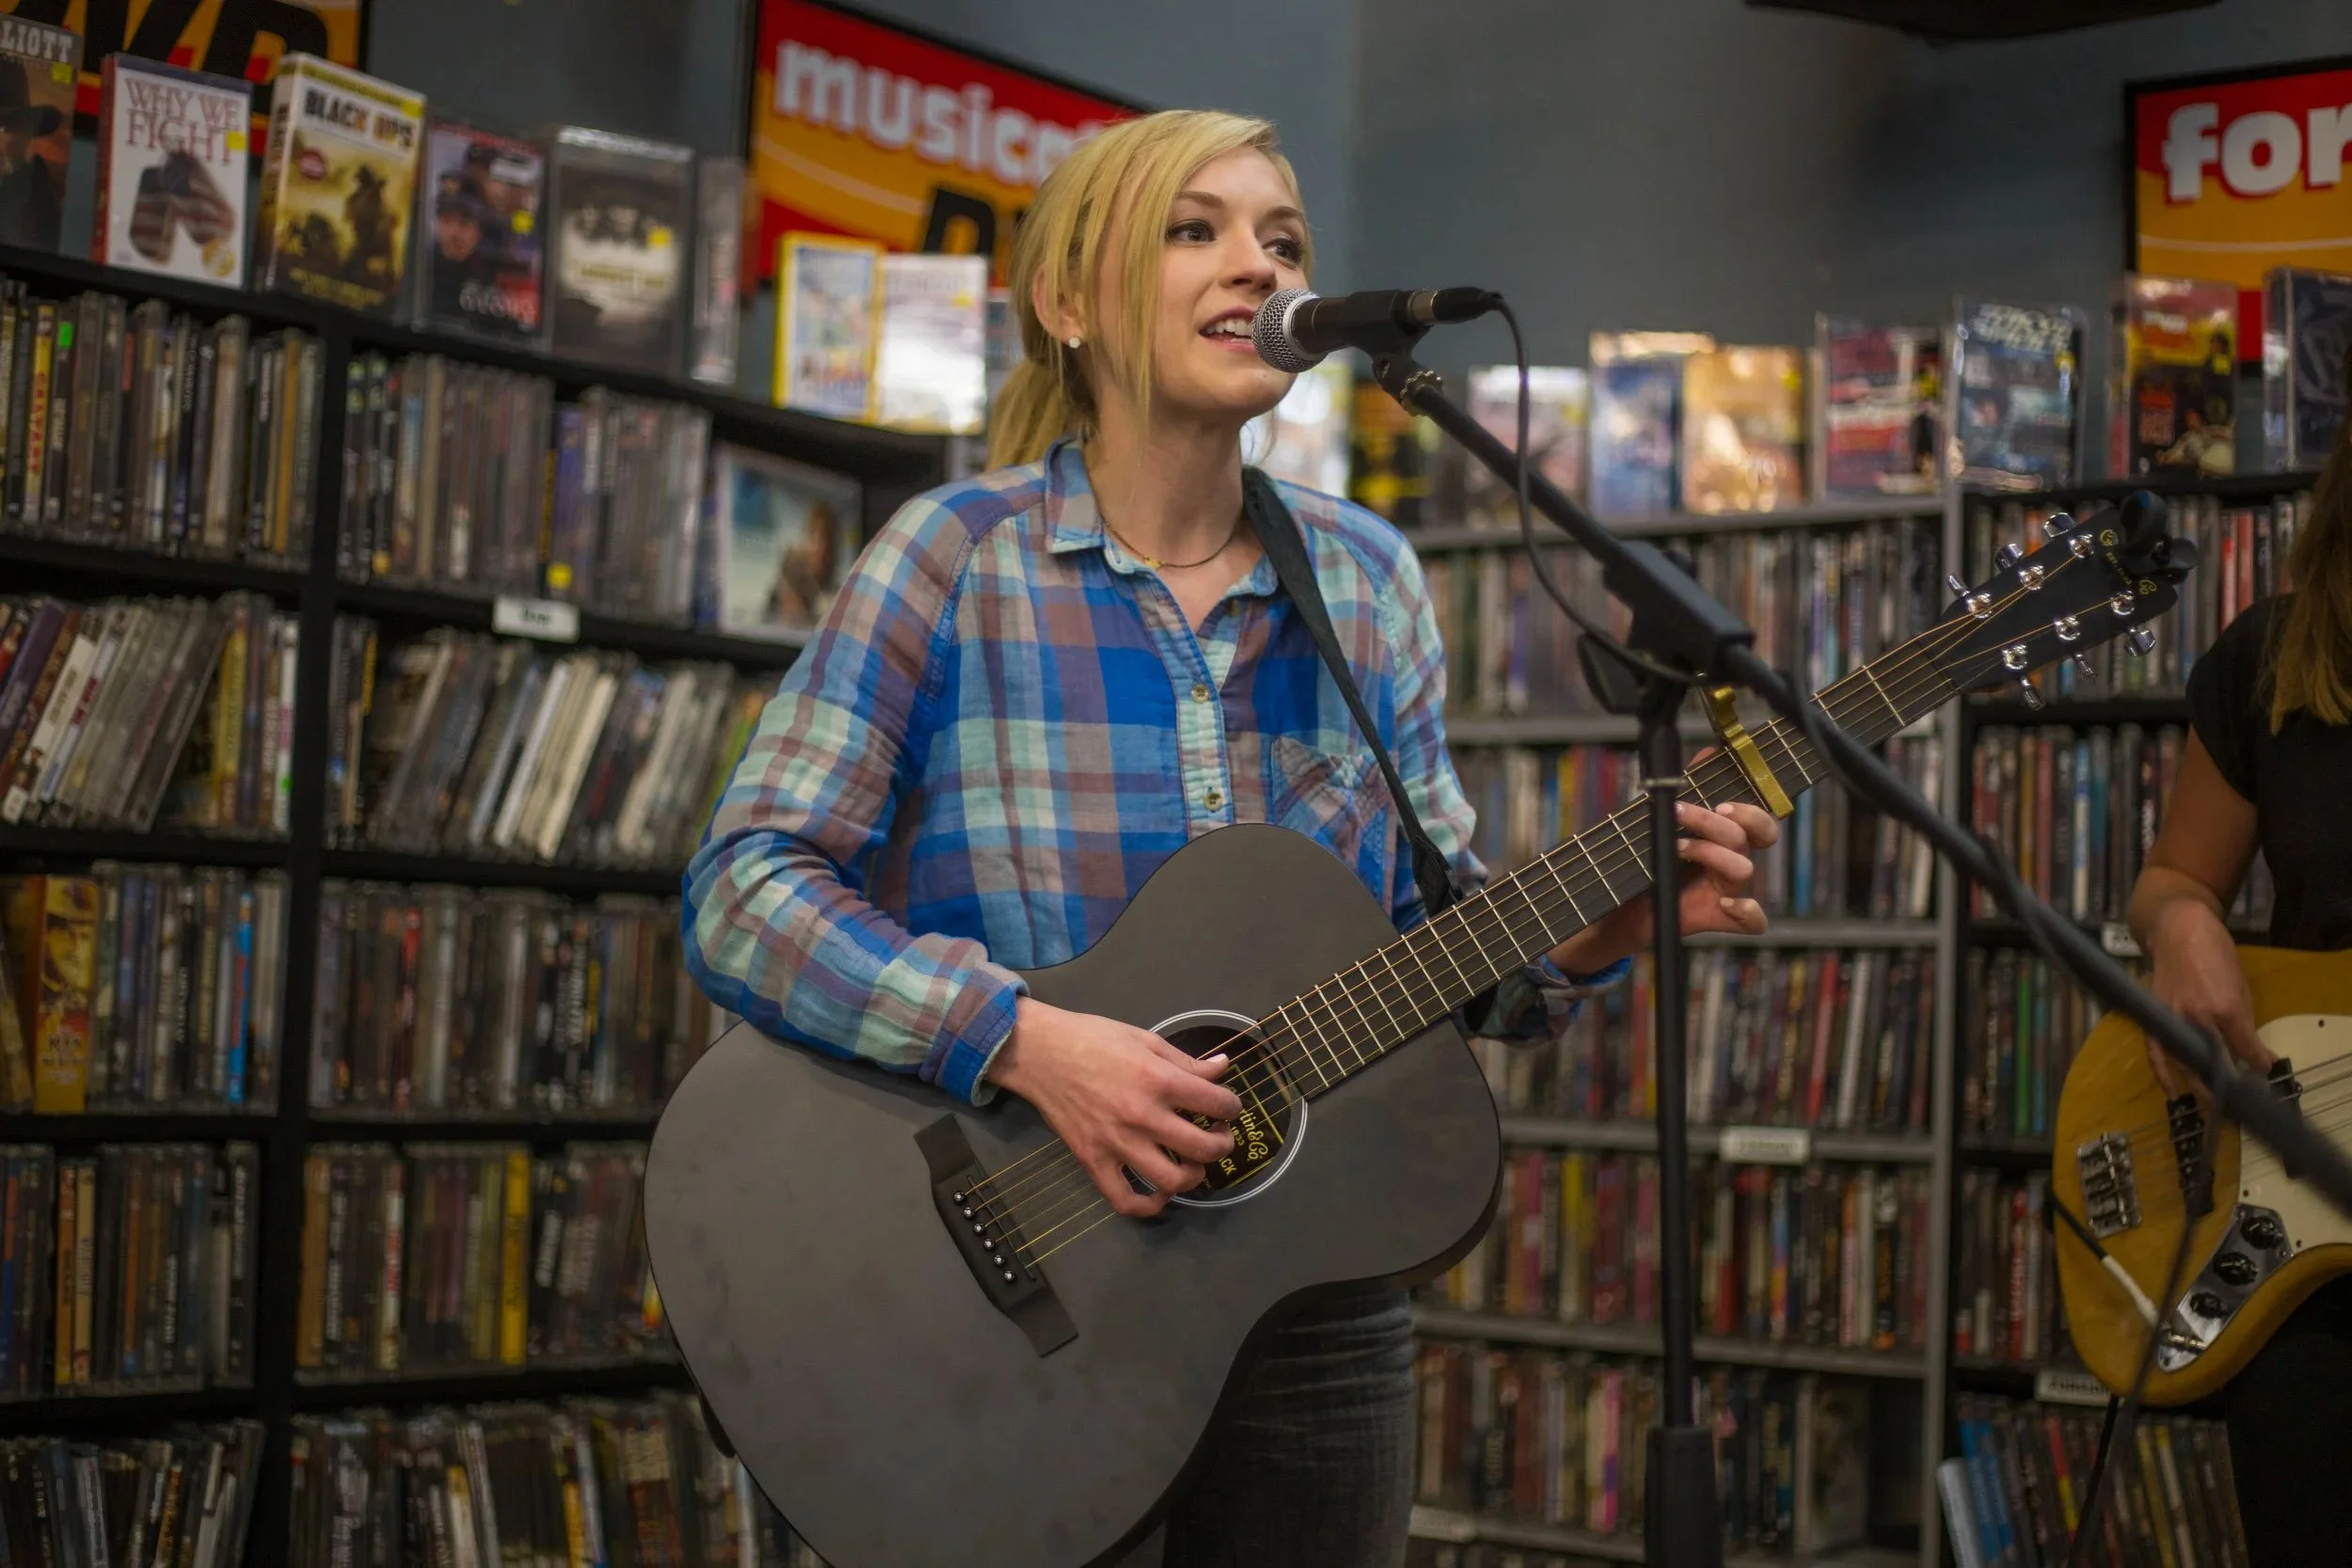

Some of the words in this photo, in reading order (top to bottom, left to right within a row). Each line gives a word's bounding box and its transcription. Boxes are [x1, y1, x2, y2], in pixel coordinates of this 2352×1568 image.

[125, 78, 193, 119] WHY
[194, 91, 241, 132] WE
[303, 87, 371, 133] BLACK
